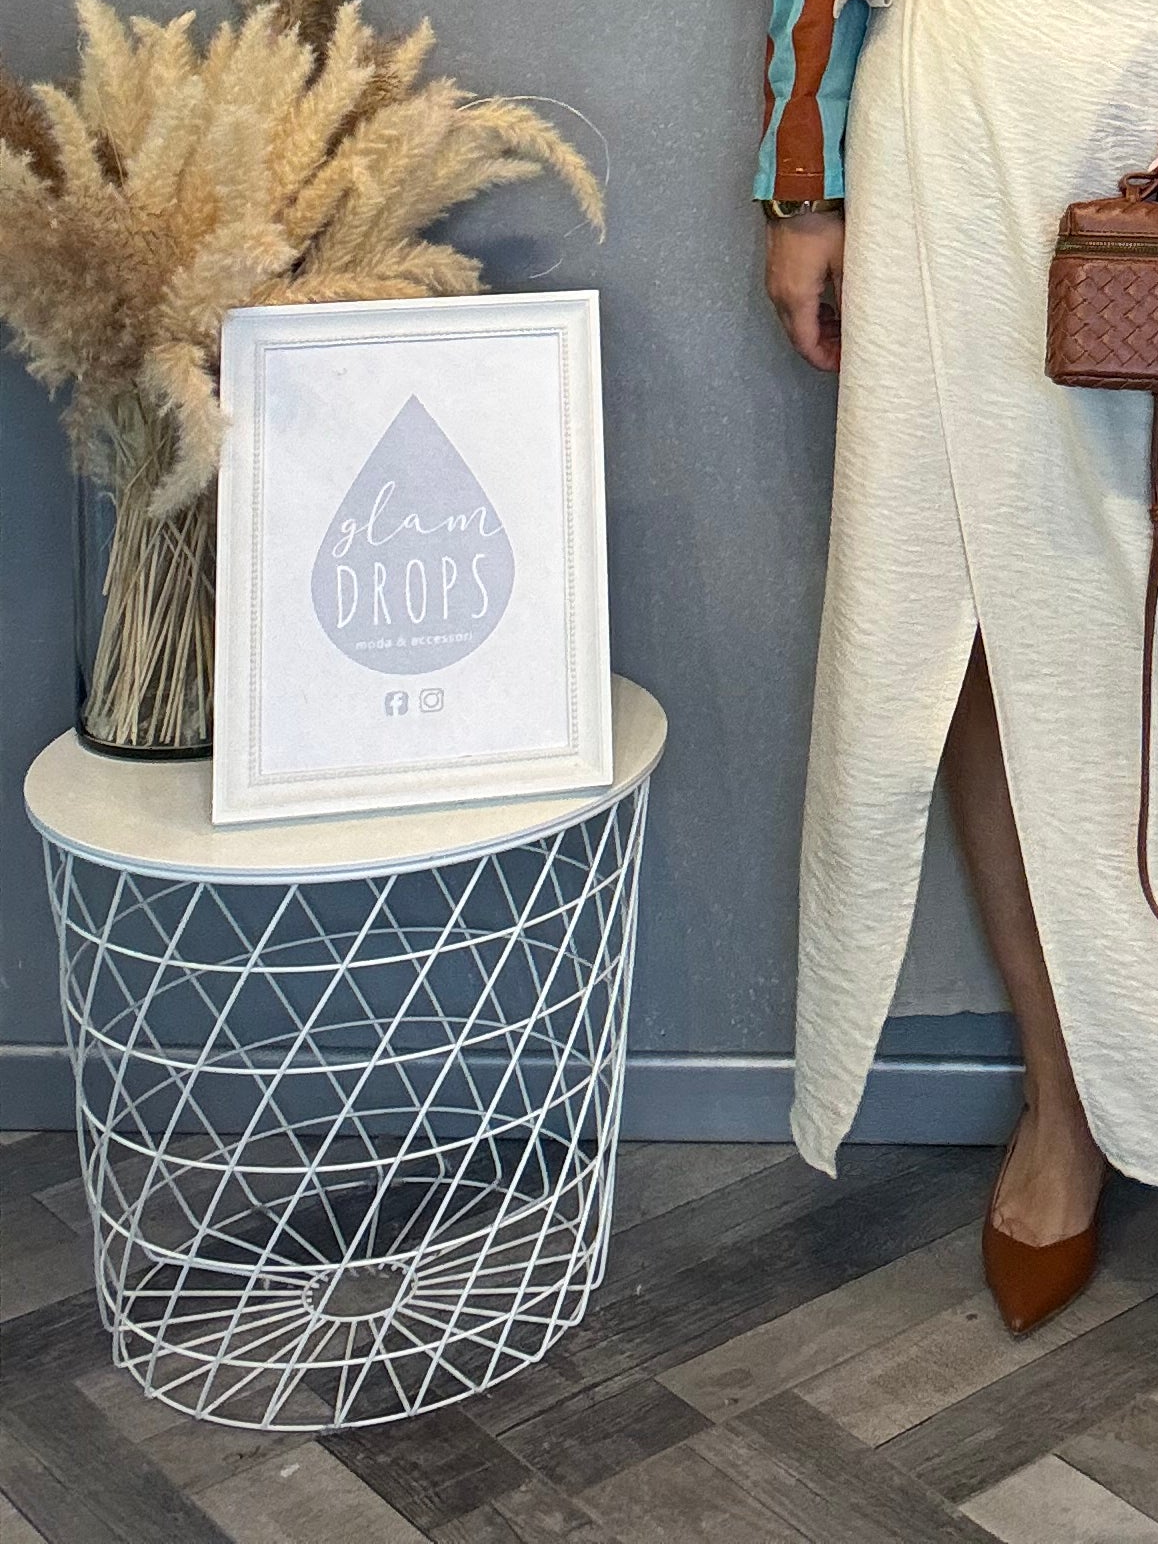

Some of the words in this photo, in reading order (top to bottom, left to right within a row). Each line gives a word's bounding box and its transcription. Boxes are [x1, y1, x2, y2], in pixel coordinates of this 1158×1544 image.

[332, 481, 503, 557] glam
[336, 554, 488, 629] DROPS
[355, 637, 392, 650] moda
[396, 637, 407, 648] &
[411, 631, 473, 646] accessori
